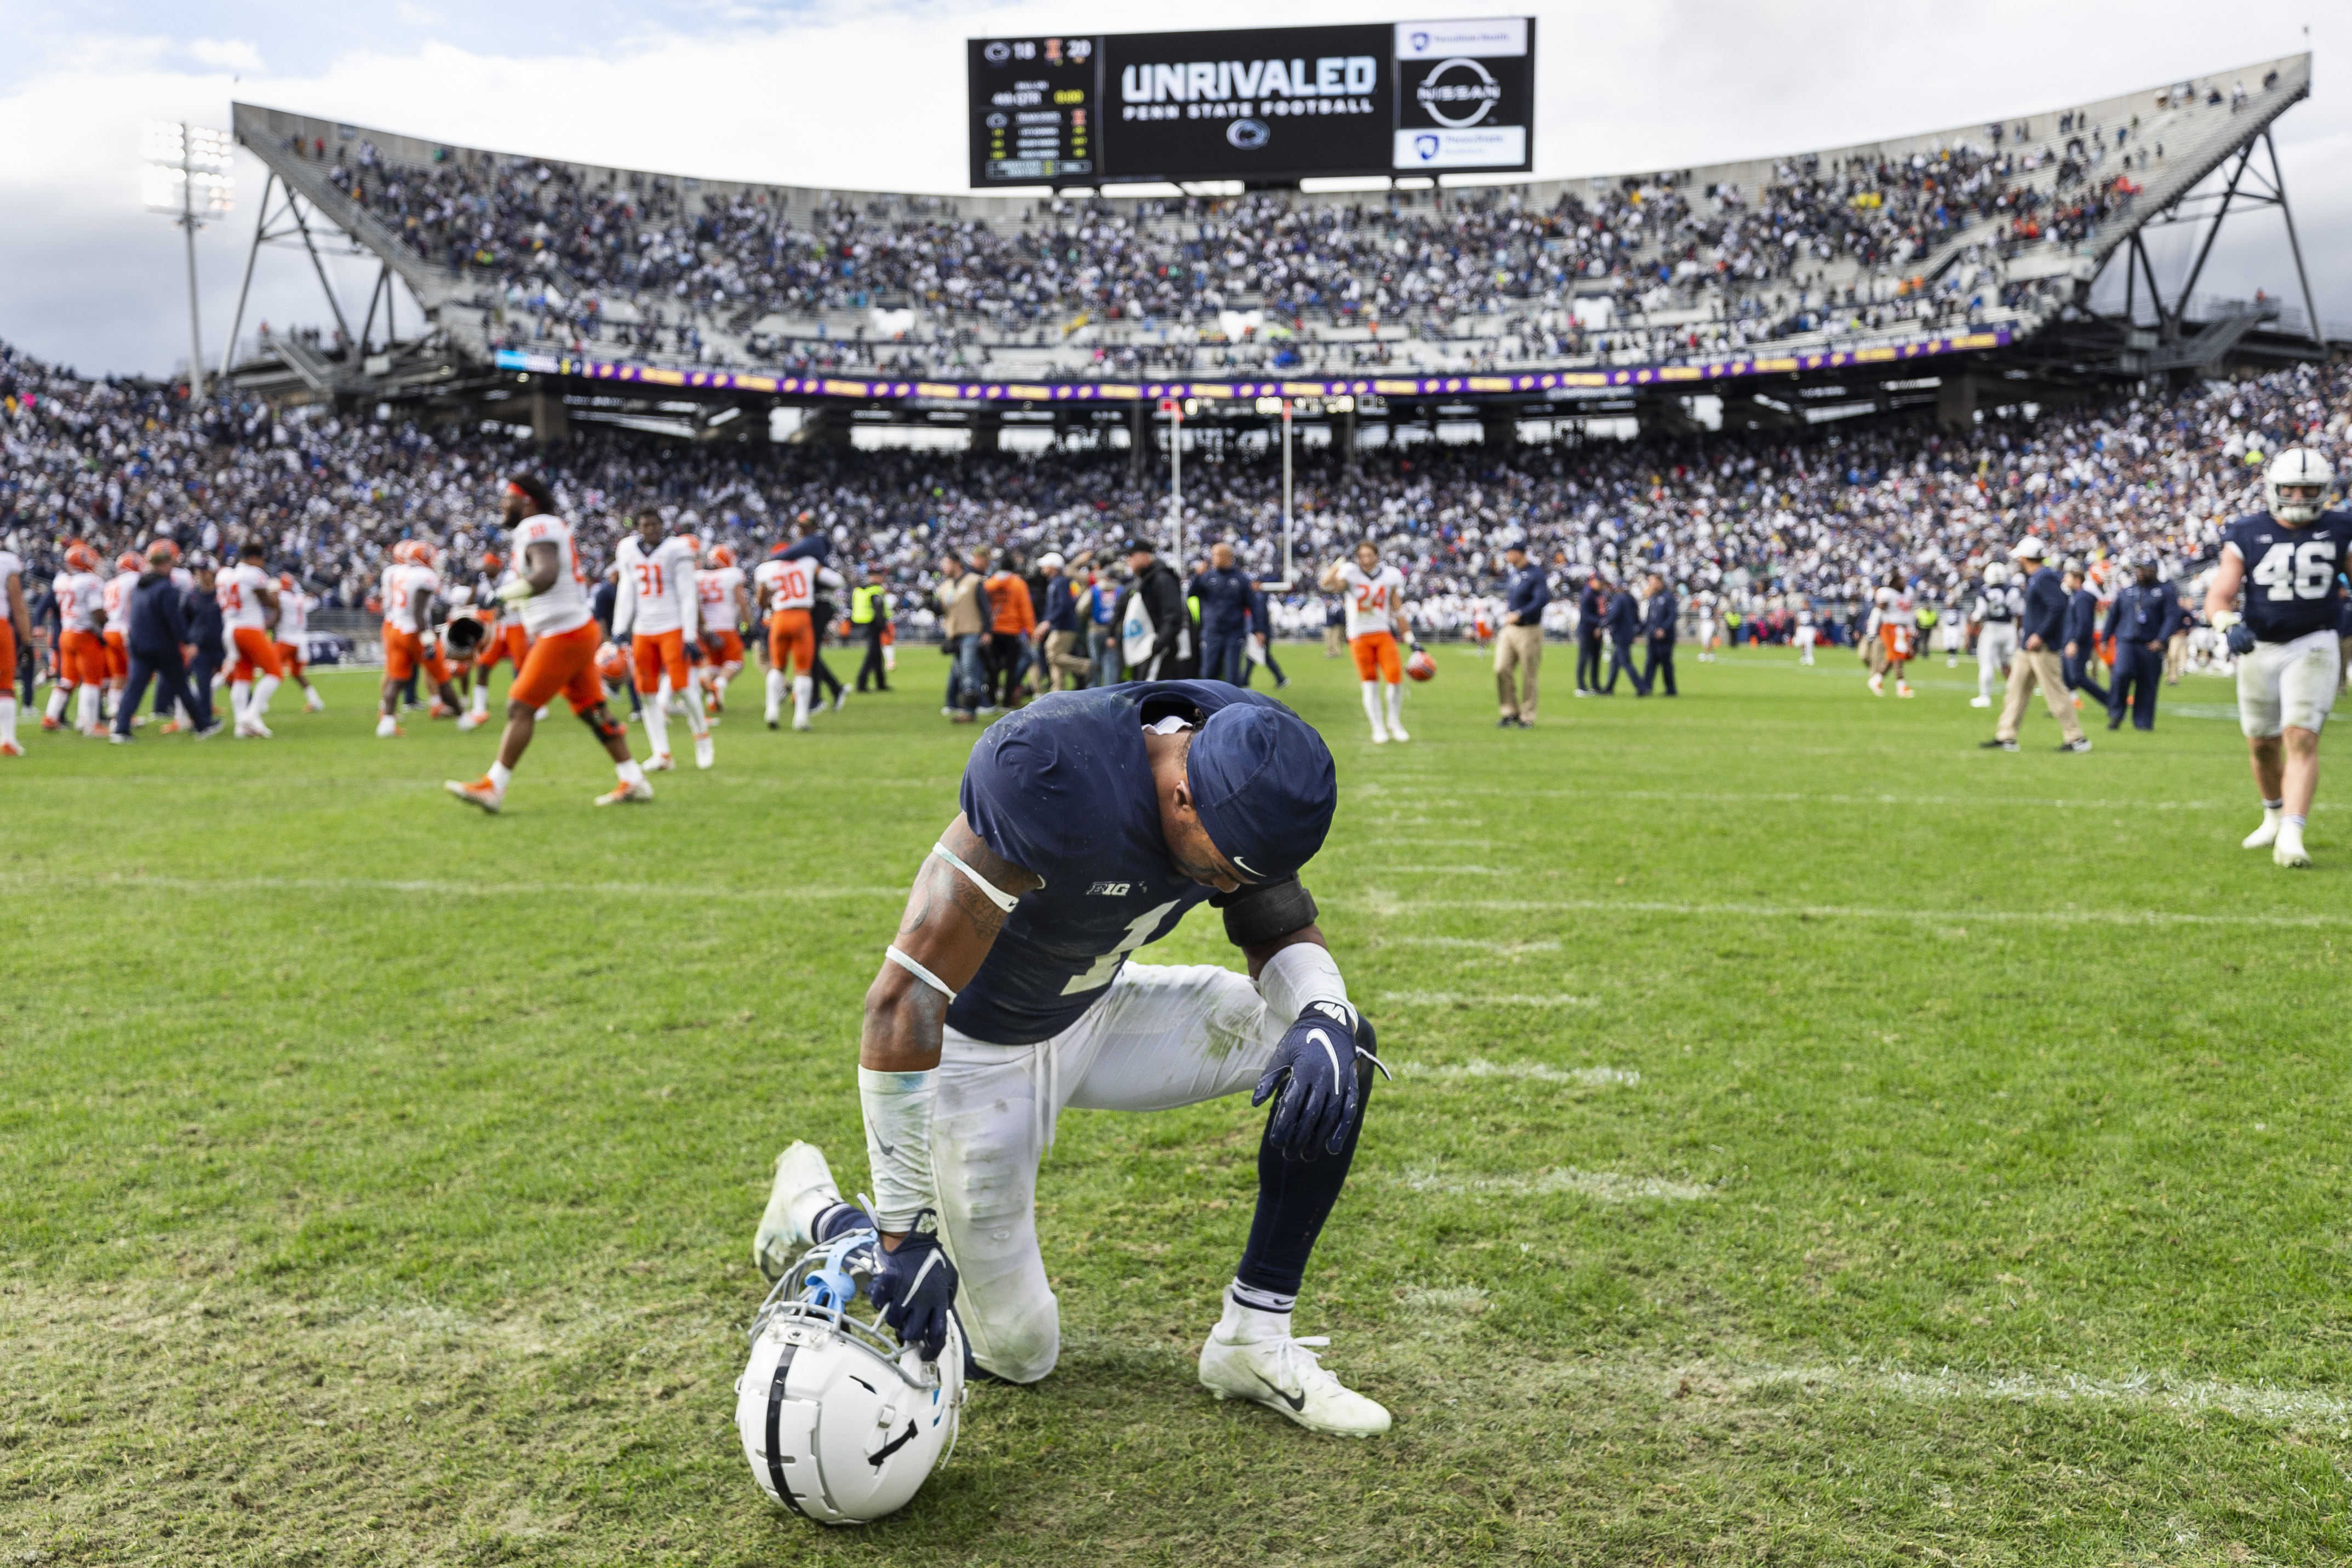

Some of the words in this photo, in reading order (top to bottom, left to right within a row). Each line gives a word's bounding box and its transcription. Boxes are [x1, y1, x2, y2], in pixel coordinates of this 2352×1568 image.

[1121, 55, 1377, 103] UNRIVALED
[1417, 84, 1501, 101] NISSAN
[1122, 105, 1180, 121] PENN
[1187, 101, 1254, 119] STATE
[1260, 97, 1374, 117] FOOTBALL
[634, 563, 662, 598] 31
[771, 570, 807, 602] 30
[2252, 541, 2337, 601] 46
[1356, 584, 1386, 611] 24
[1060, 899, 1181, 996] 1
[867, 1417, 919, 1467] 1
